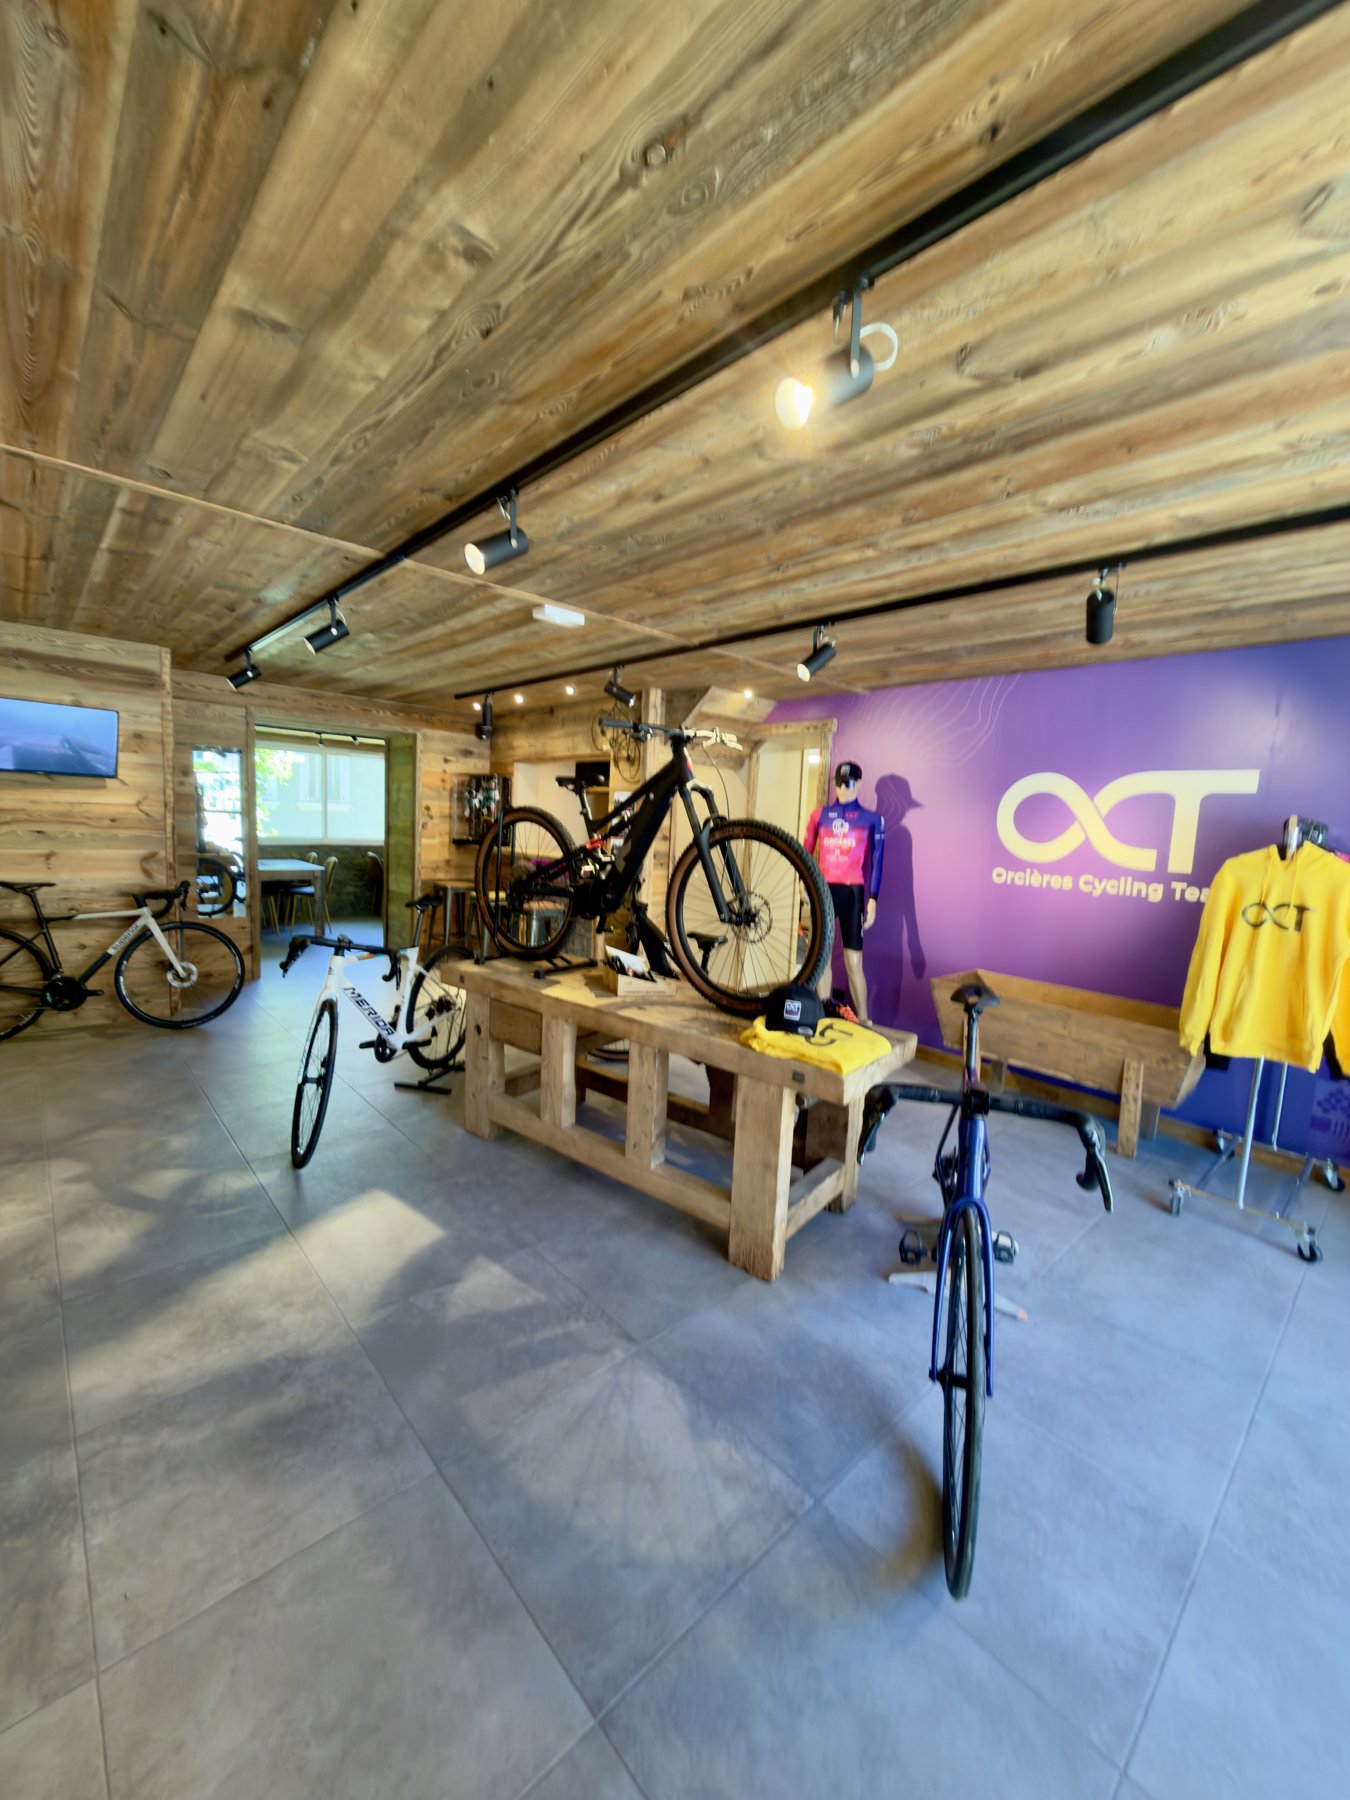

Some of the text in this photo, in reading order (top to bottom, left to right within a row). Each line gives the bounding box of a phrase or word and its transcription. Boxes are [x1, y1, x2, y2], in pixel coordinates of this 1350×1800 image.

[996, 769, 1260, 875] OCT
[992, 866, 1073, 890] Orcières
[1079, 874, 1164, 903] Cycling
[343, 986, 395, 1036] MERIDA
